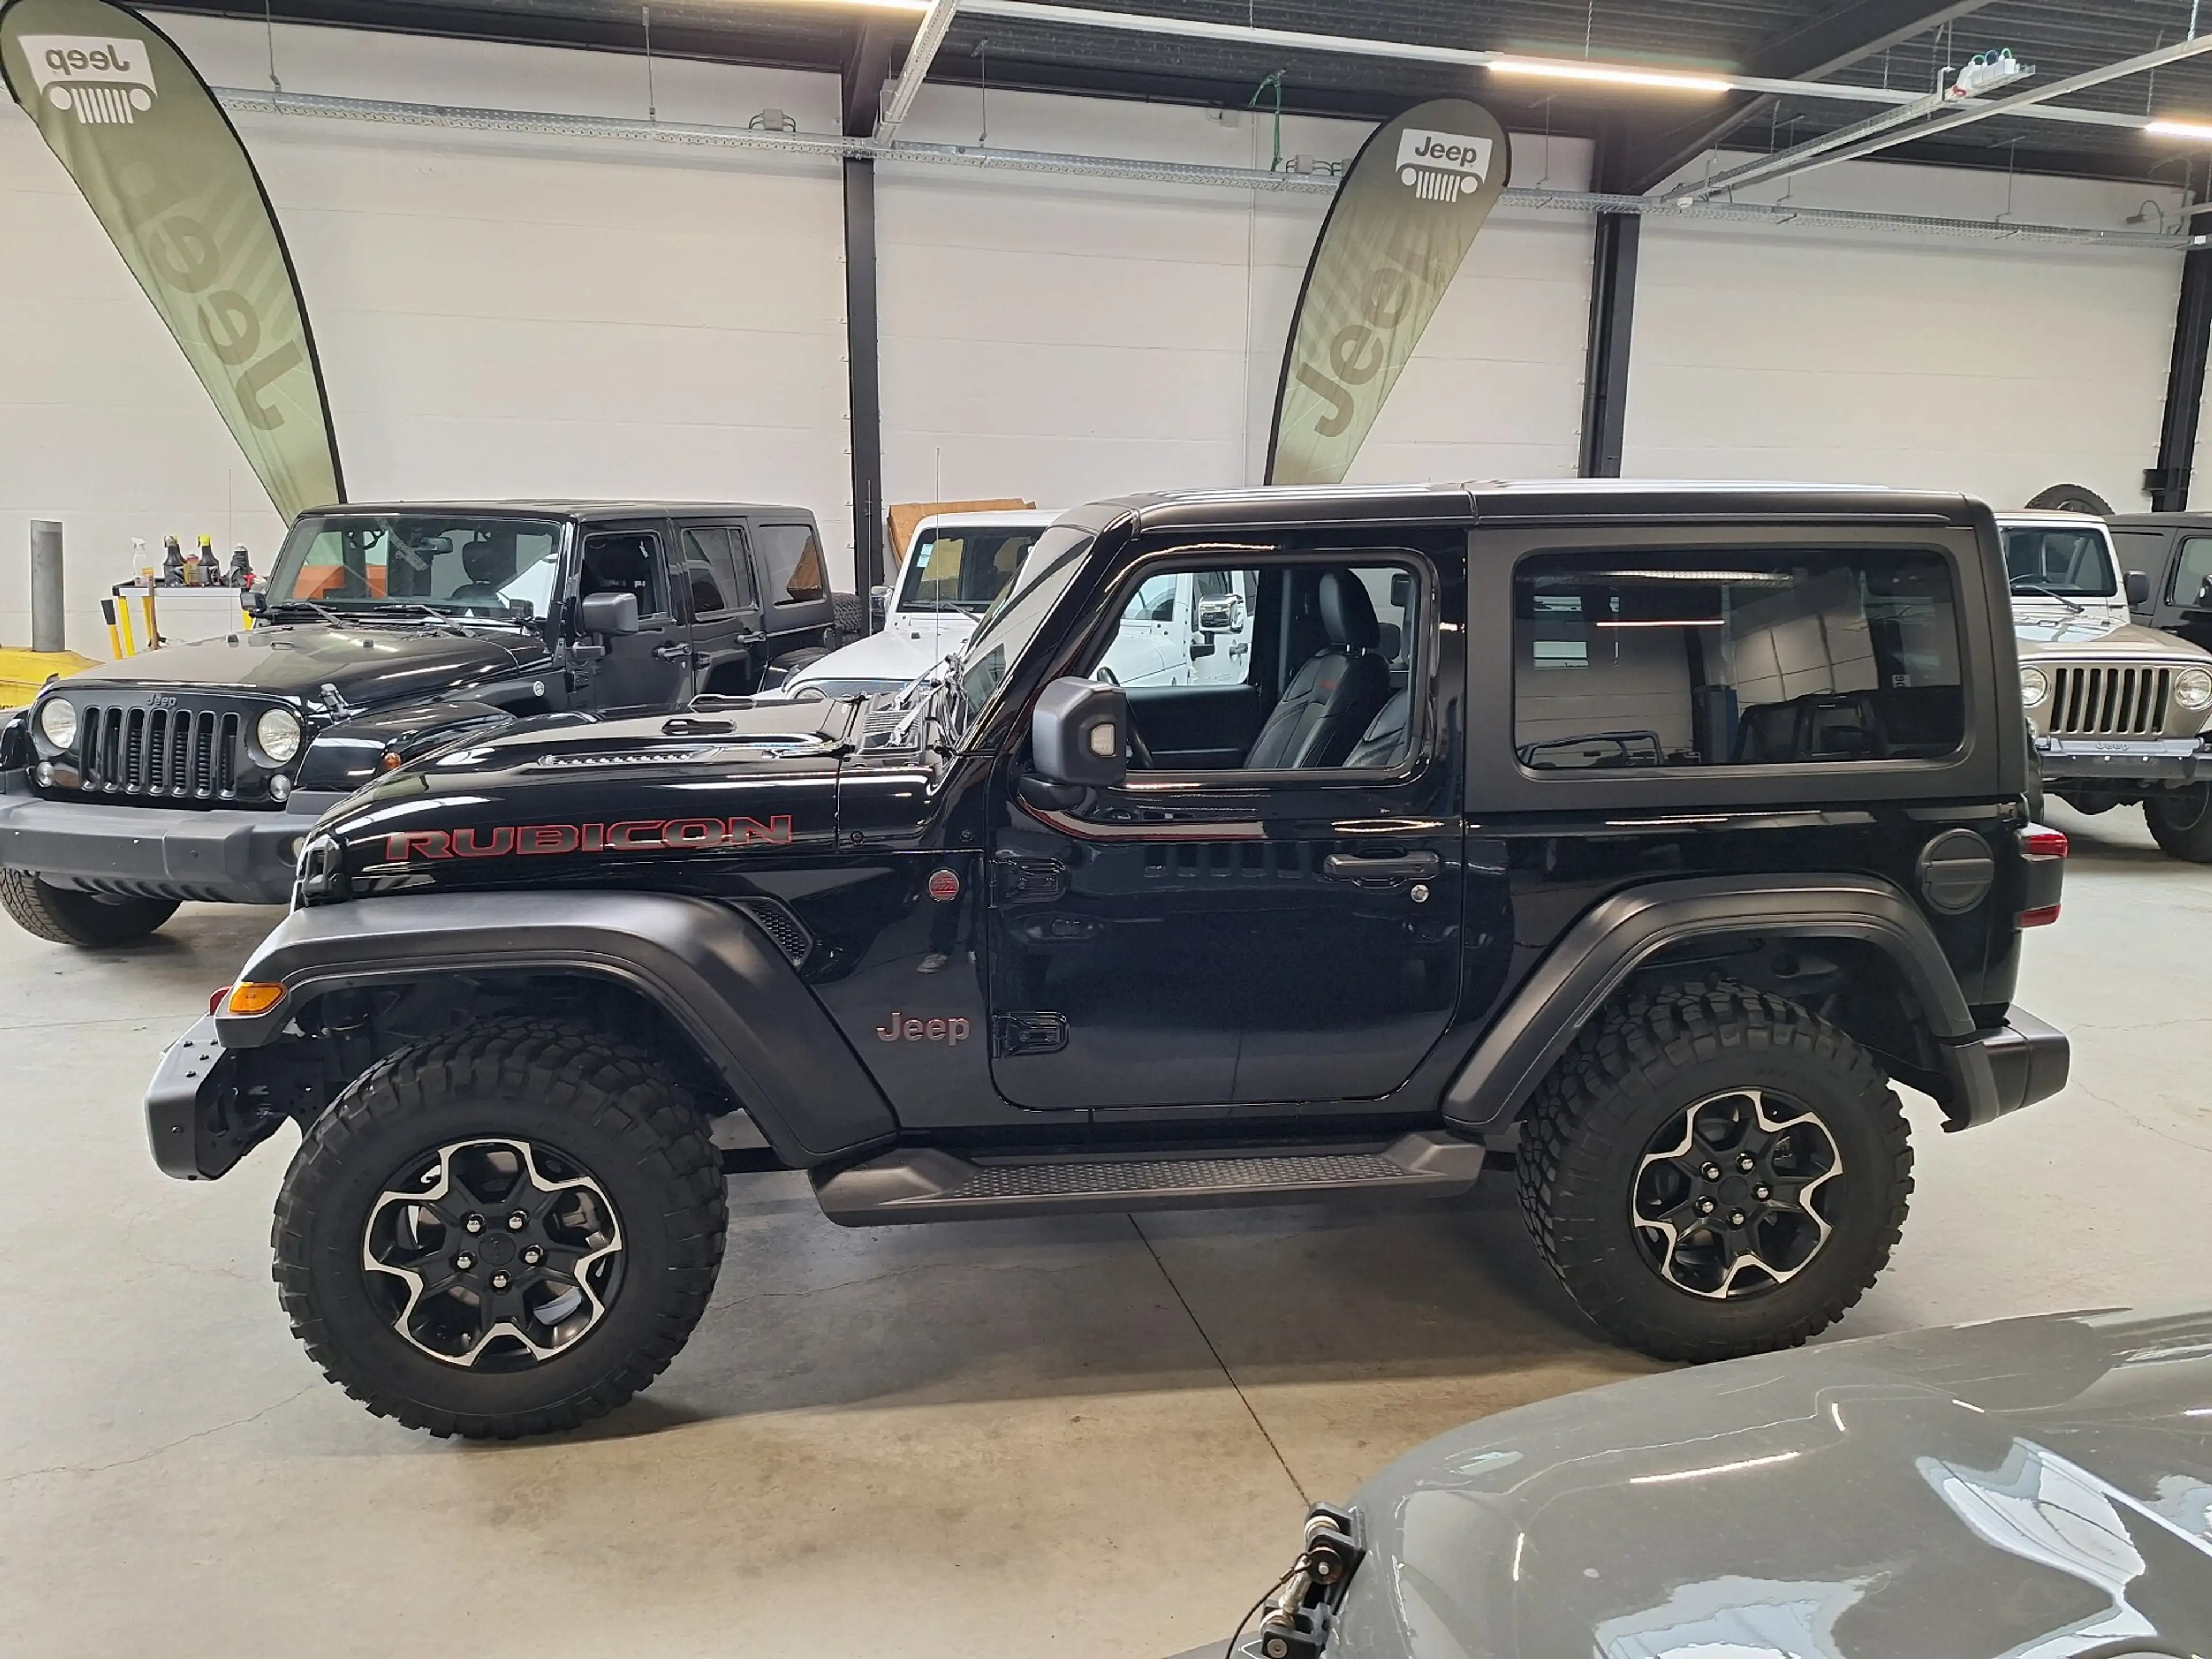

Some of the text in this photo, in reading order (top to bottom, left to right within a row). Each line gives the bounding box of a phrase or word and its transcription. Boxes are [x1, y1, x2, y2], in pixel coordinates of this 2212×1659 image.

[1415, 136, 1476, 166] Jeep
[147, 693, 177, 709] Jeep
[386, 815, 793, 860] RUBICON
[876, 1012, 971, 1046] Jeep
